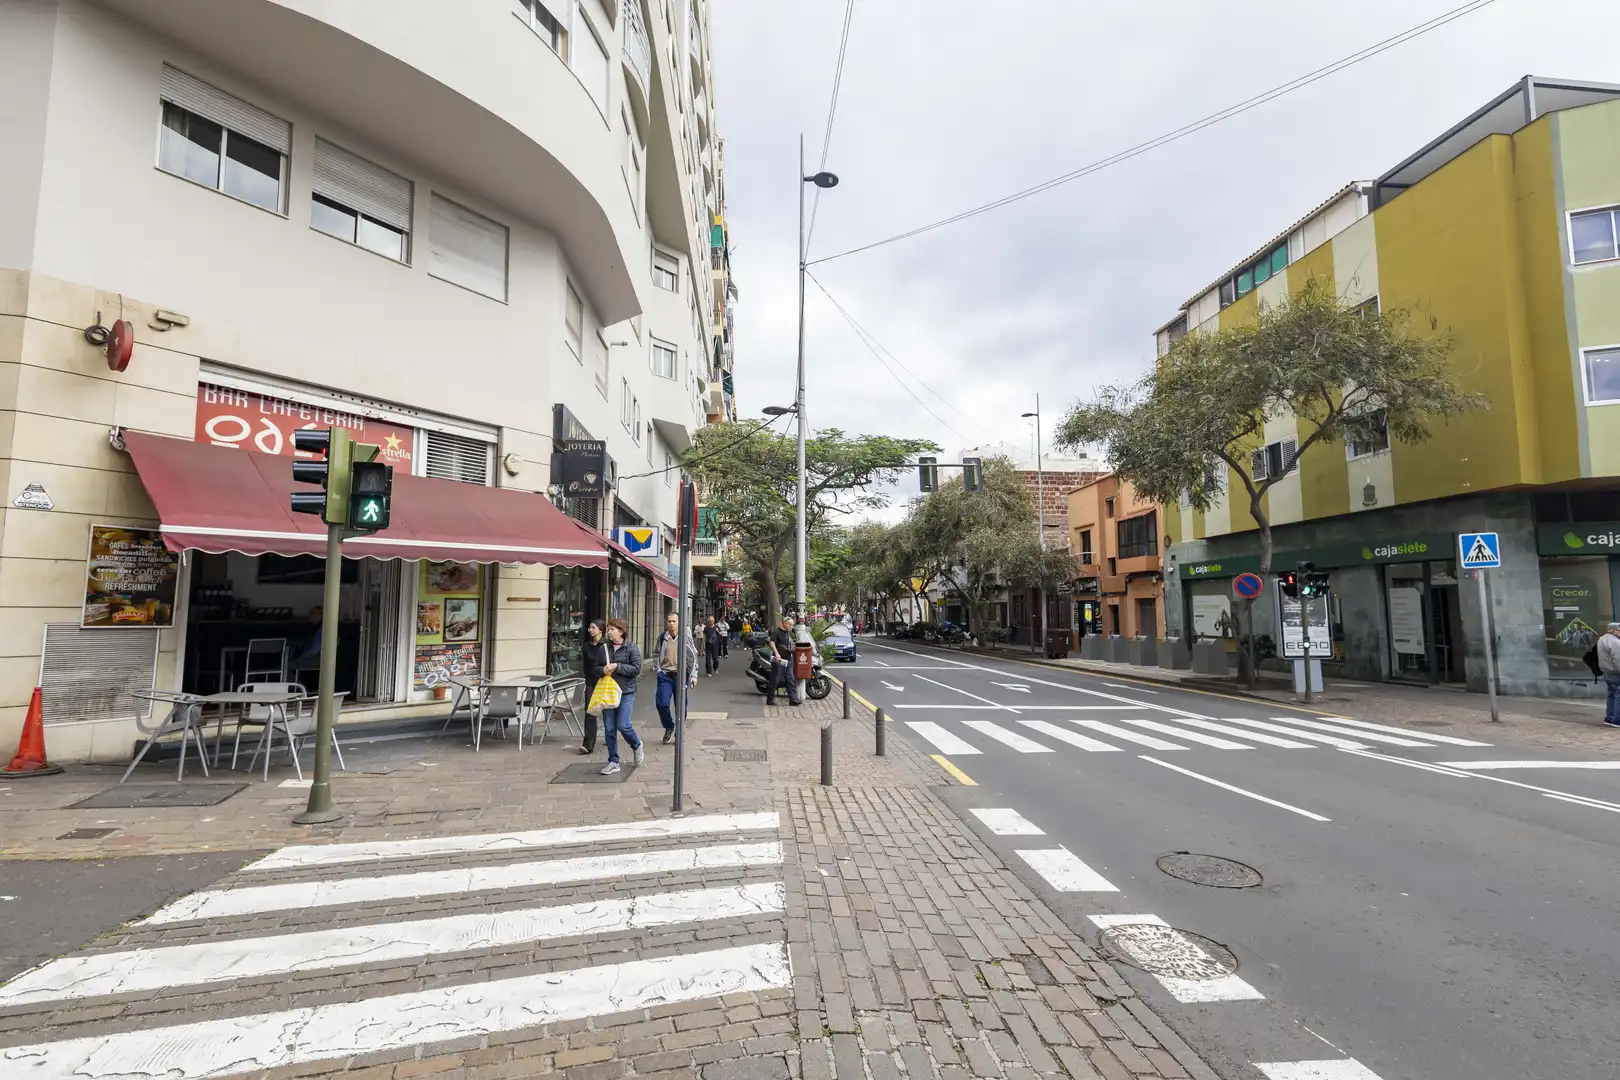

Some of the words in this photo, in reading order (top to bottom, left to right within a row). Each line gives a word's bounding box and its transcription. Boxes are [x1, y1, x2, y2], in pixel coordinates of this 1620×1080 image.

[204, 383, 248, 408] BAR
[259, 393, 364, 431] CAFETERIA
[565, 443, 602, 451] JOYERIA
[1374, 541, 1427, 558] cajasiete
[132, 568, 166, 577] coffee
[1195, 563, 1222, 575] cajasiete
[104, 582, 156, 591] REFRESHMENT
[1552, 588, 1592, 597] Crecer.
